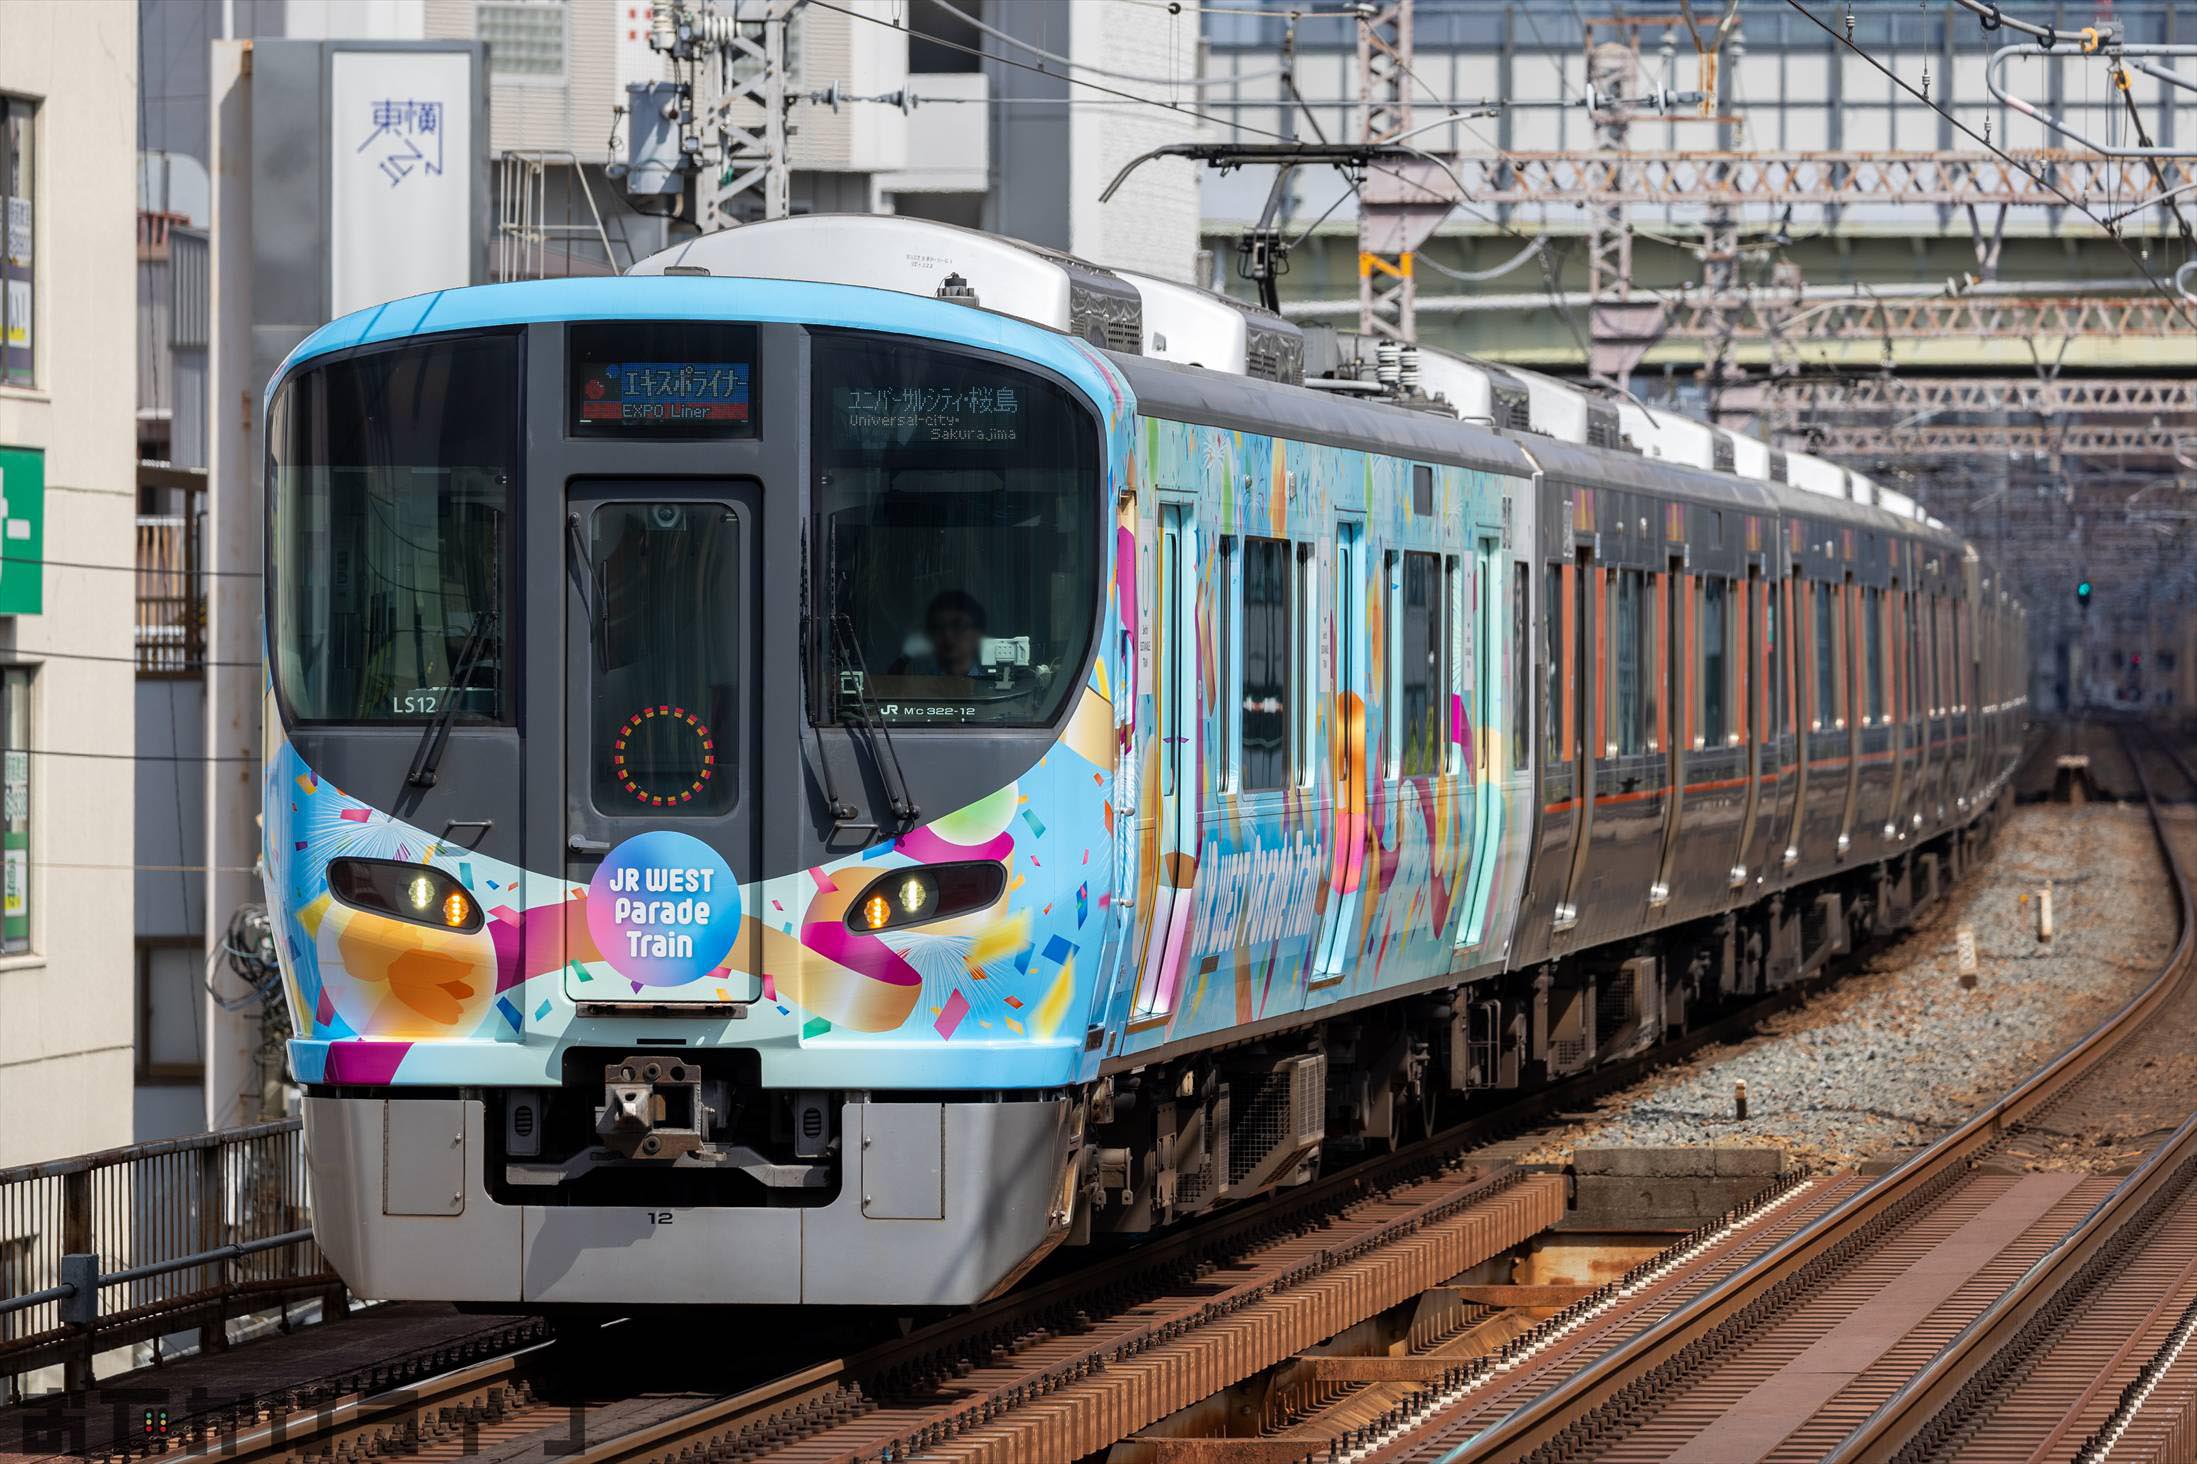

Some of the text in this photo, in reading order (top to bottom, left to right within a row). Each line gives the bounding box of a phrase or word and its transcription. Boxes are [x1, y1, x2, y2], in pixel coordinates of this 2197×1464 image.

[624, 365, 747, 398] エキスポライナー
[622, 404, 711, 419] EXPO Liner
[930, 428, 1017, 442] Sakurajima
[393, 696, 437, 713] LS12
[880, 704, 899, 715] JR
[926, 707, 976, 716] 322-12
[609, 868, 715, 893] JR WEST
[615, 898, 711, 925] Parade
[626, 930, 693, 958] Train
[648, 1212, 674, 1225] 12
